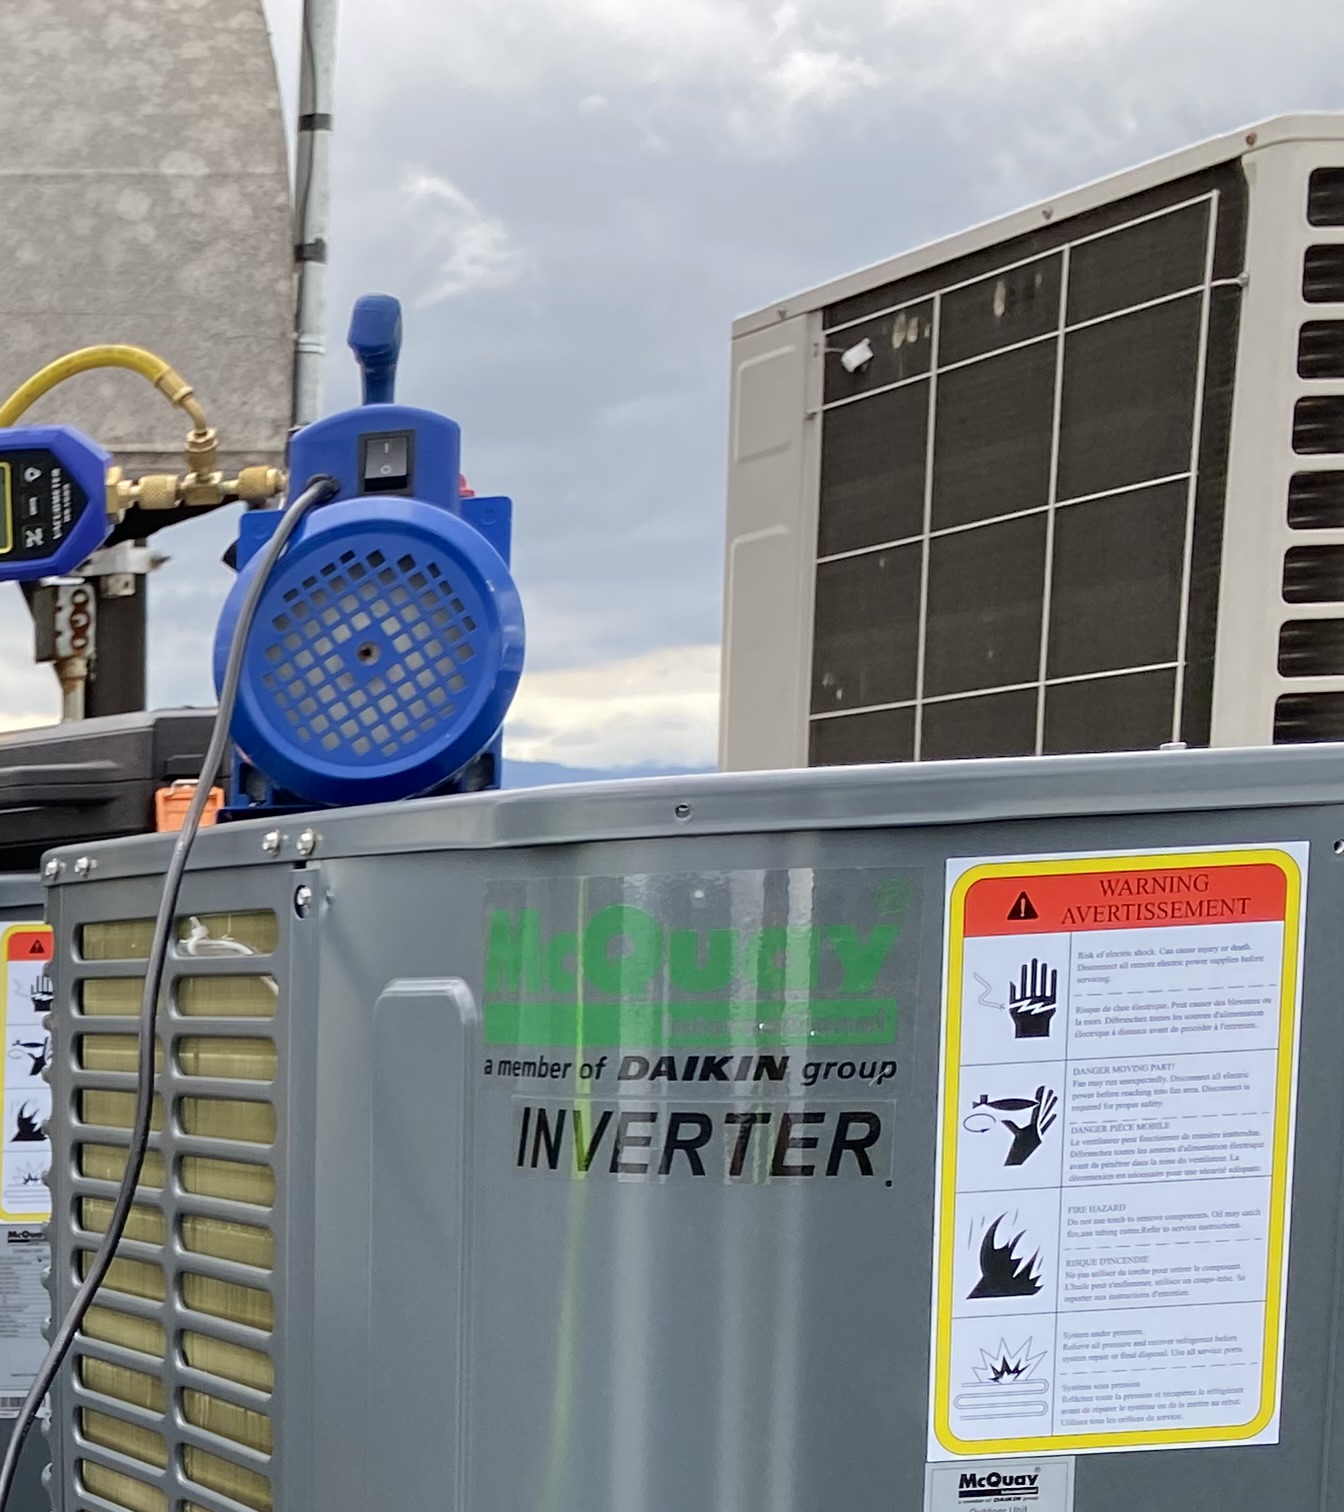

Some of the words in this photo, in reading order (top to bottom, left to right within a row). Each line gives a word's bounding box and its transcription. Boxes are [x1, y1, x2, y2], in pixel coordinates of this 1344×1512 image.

[1099, 874, 1210, 897] WARNING
[1060, 897, 1251, 925] AVERTISSEMENT
[484, 904, 901, 995] McQuay
[483, 1060, 493, 1076] a
[497, 1056, 572, 1079] member
[579, 1055, 607, 1080] of
[617, 1055, 789, 1082] DAIKIN
[801, 1058, 898, 1086] group
[516, 1106, 882, 1178] INVERTER
[958, 1471, 1039, 1489] McQuay
